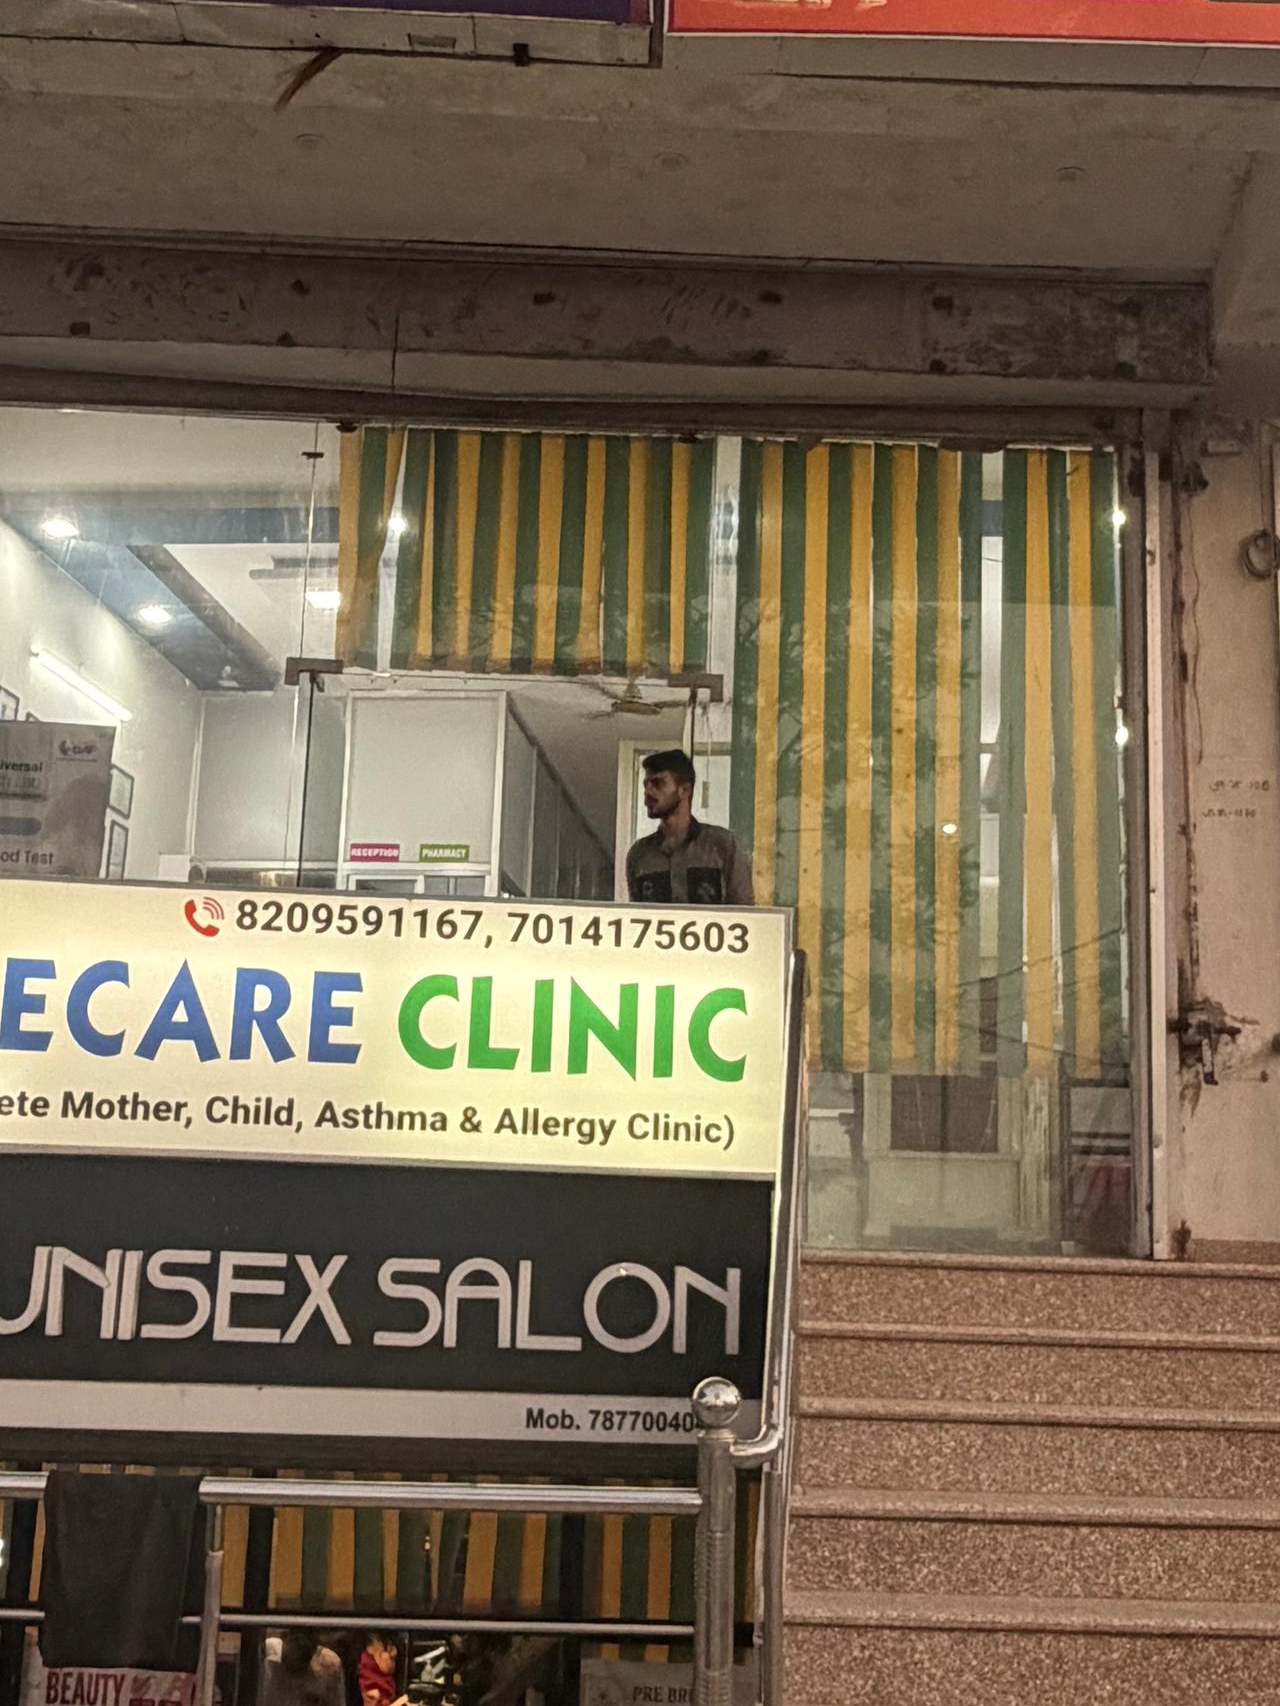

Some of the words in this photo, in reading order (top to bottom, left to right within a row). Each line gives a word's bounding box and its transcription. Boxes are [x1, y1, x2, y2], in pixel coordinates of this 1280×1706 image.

[24, 849, 54, 865] Test
[351, 848, 399, 857] RECEPTION
[422, 848, 466, 858] PHARMACY
[236, 899, 494, 949] 8209591167,
[507, 912, 750, 954] 7014175603
[398, 973, 748, 1083] CLINIC
[61, 1091, 194, 1129] Mother,
[206, 1095, 304, 1134] Child,
[314, 1100, 447, 1132] Asthma
[460, 1106, 483, 1134] &
[494, 1107, 617, 1145] Allergy
[627, 1113, 735, 1151] Clinic)
[373, 1257, 741, 1356] SALON
[525, 1408, 580, 1430] Mob.
[588, 1409, 700, 1433] 78770040
[46, 1671, 125, 1706] BEAUTY
[632, 1686, 663, 1704] PRE
